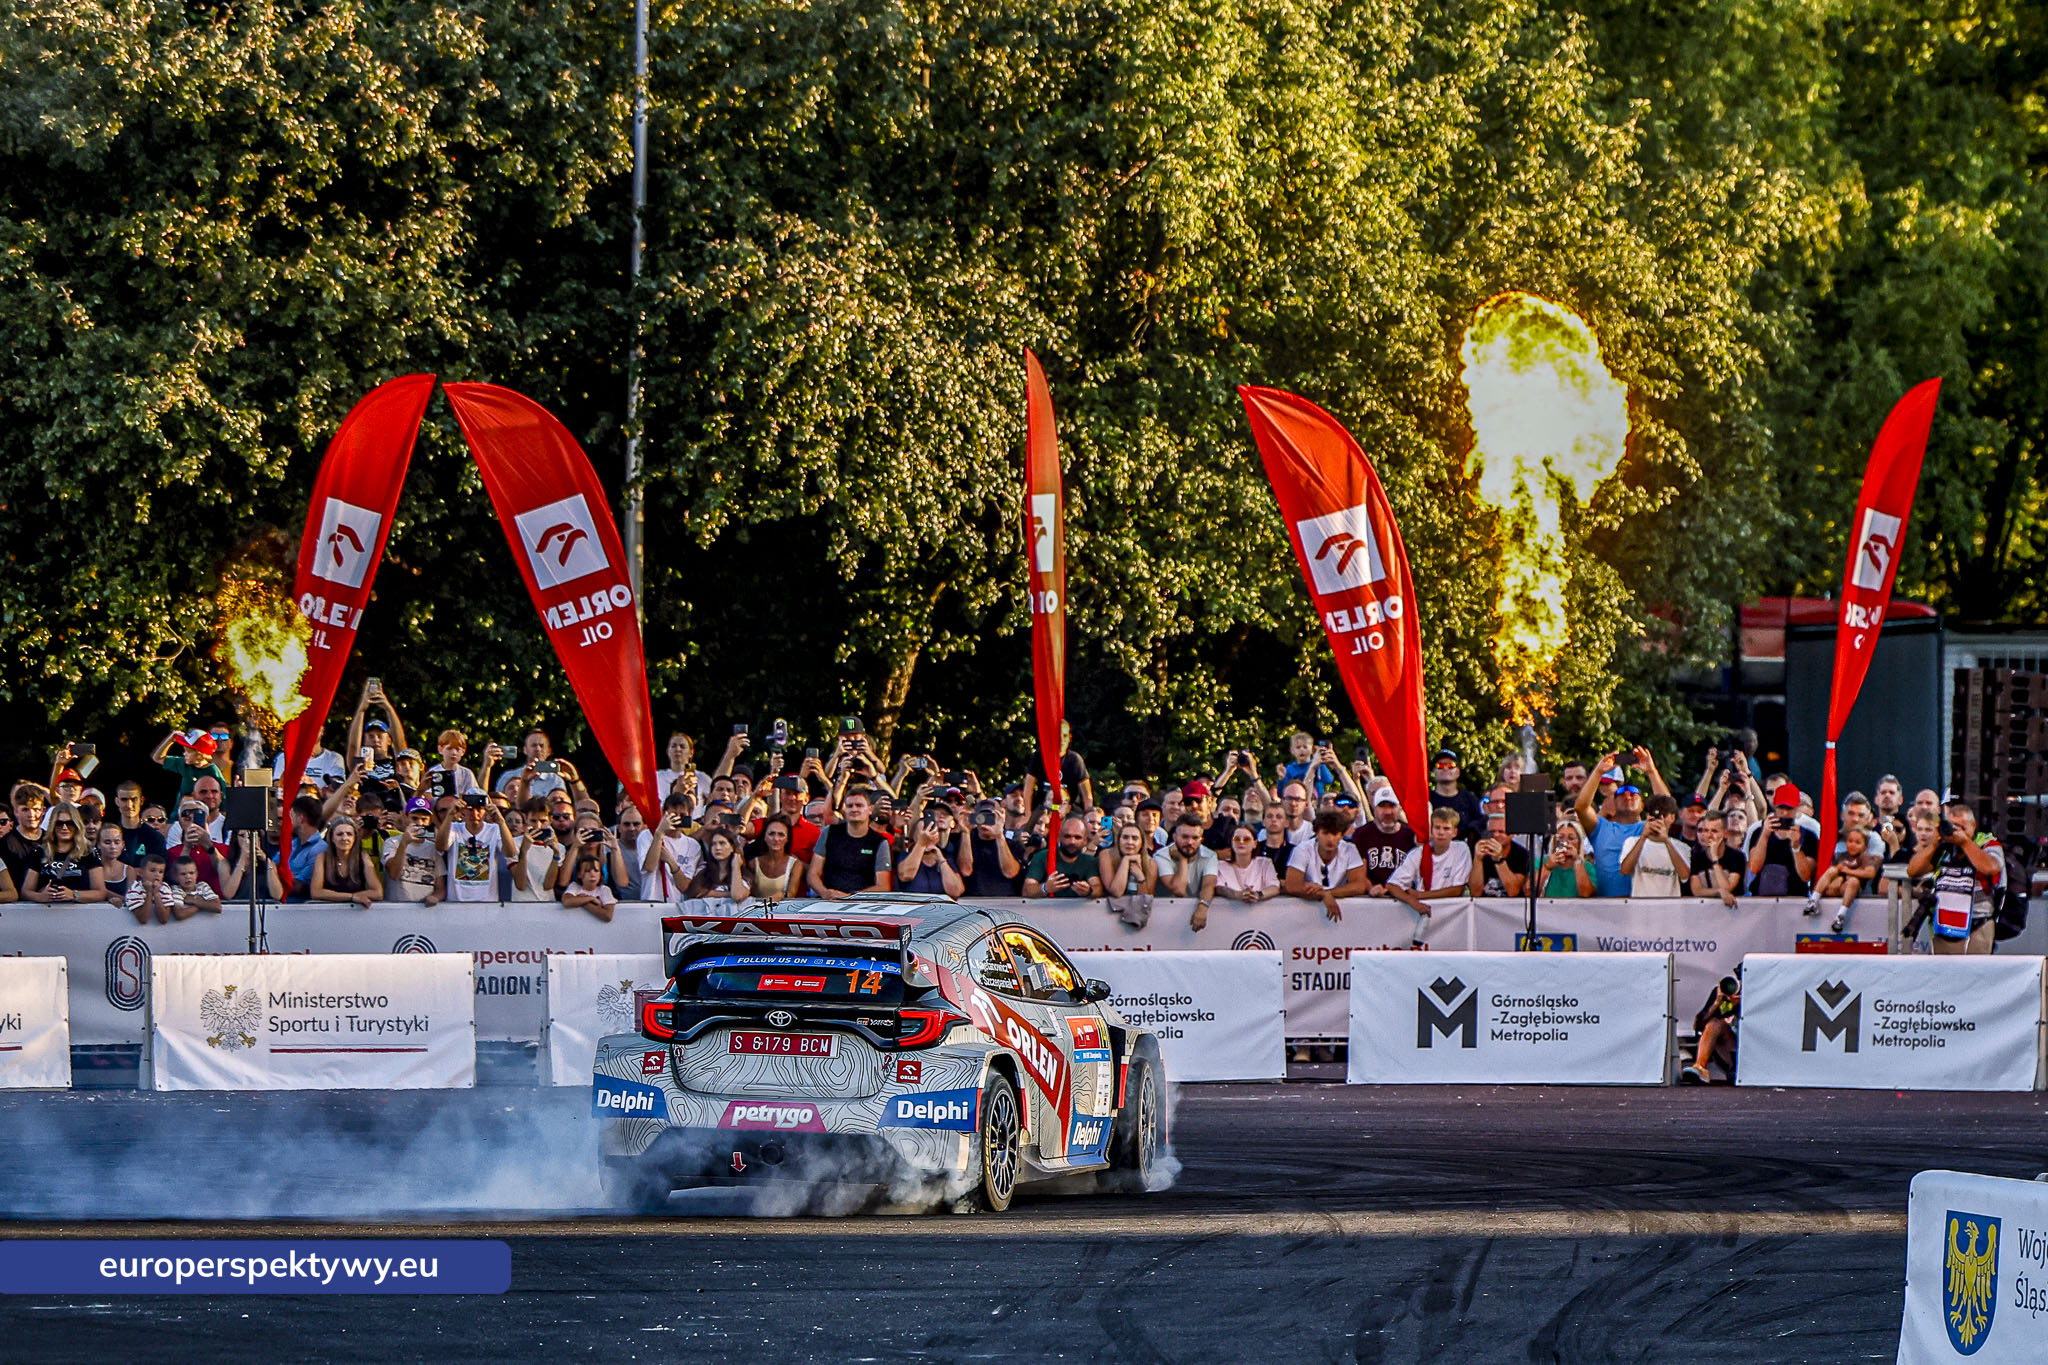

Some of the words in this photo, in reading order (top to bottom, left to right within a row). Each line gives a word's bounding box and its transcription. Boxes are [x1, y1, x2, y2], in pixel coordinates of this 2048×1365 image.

[846, 969, 882, 995] 14
[268, 991, 388, 1009] Ministerstwo
[1491, 994, 1579, 1010] Górnośląsko
[1874, 999, 1956, 1016] Górnośląsko
[268, 1015, 330, 1036] Sportu
[335, 1015, 340, 1033] i
[345, 1014, 429, 1036] Turystyki
[1491, 1028, 1569, 1045] Metropolia
[734, 1035, 743, 1050] S
[752, 1036, 791, 1051] 6179
[800, 1039, 828, 1053] BCM
[1007, 1017, 1057, 1091] ORLEN
[1872, 1034, 1946, 1050] Metropolia
[597, 1088, 654, 1112] Delphi
[897, 1100, 969, 1124] Delphi
[731, 1104, 814, 1129] petrygo
[1072, 1120, 1104, 1151] Delphi
[2018, 1227, 2048, 1270] Woj
[2014, 1270, 2048, 1320] Śląs
